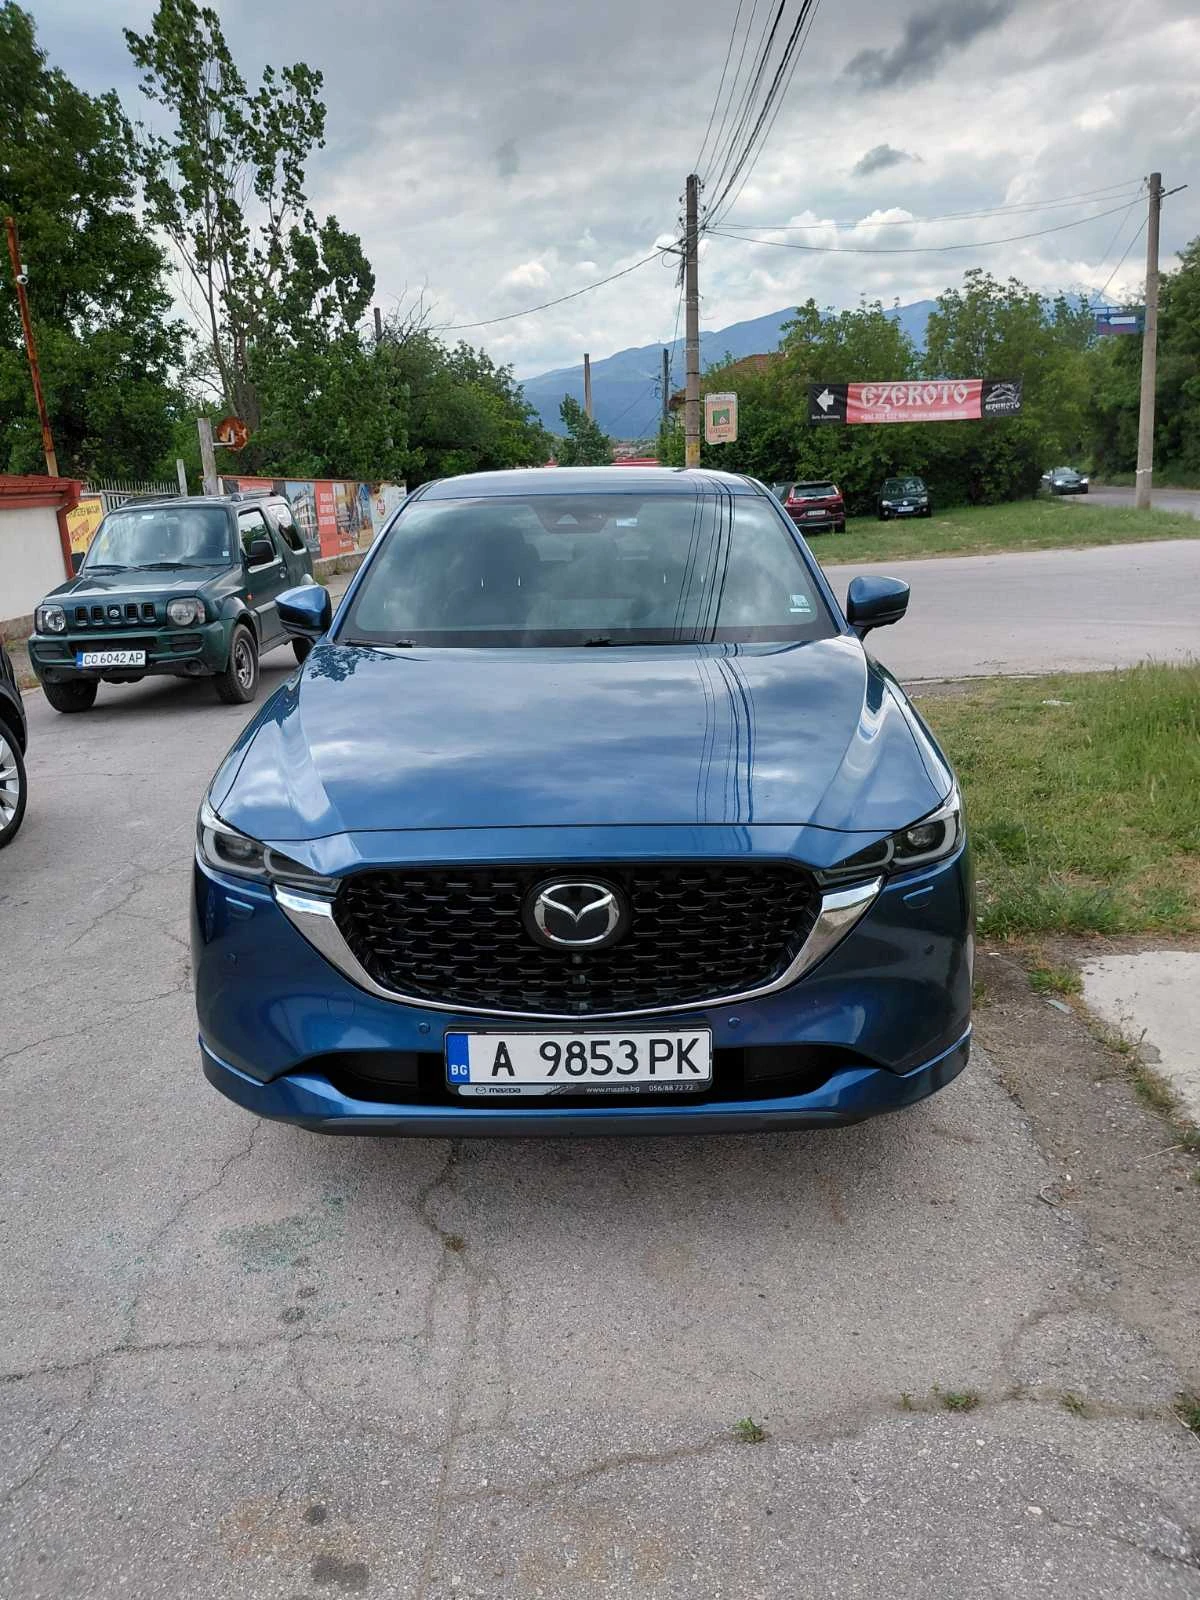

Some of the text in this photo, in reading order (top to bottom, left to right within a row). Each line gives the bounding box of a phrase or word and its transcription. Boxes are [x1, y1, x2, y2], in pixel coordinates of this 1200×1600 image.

[84, 652, 143, 665] CO 6042 AP
[491, 1037, 701, 1077] A 9853 PK
[451, 1064, 468, 1076] BG
[586, 1085, 640, 1094] www.mazda.bg
